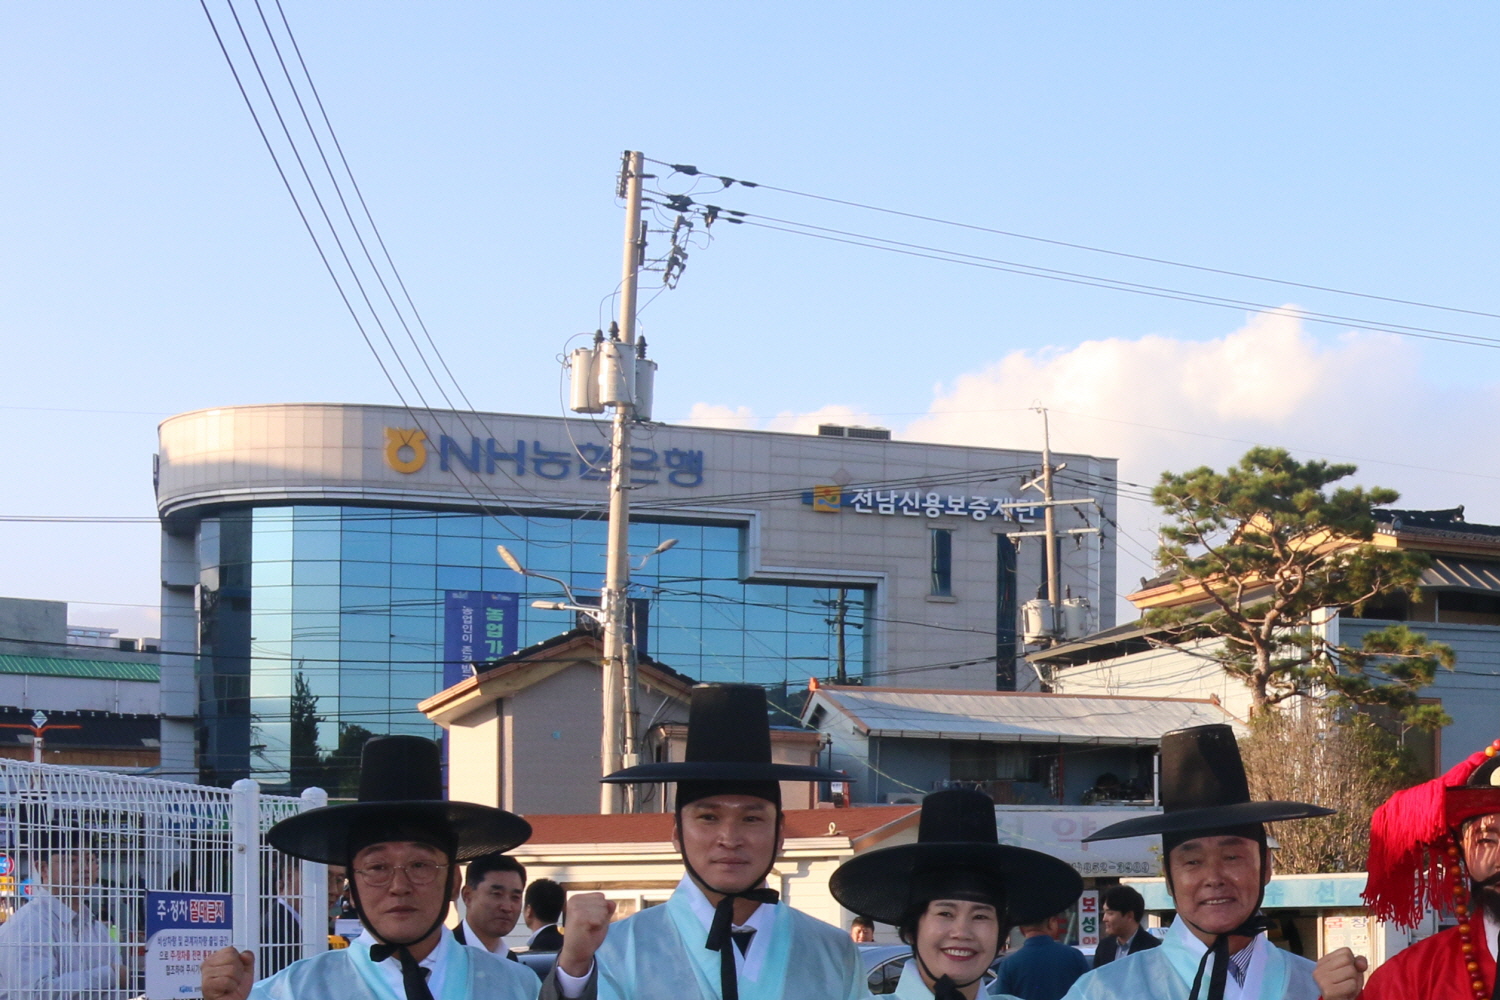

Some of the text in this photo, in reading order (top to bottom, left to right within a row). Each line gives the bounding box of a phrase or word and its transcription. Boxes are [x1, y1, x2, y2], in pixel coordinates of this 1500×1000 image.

[439, 433, 704, 488] NH농협은행
[850, 488, 1037, 524] 전남신용보증재단
[190, 899, 225, 923] 절대금지
